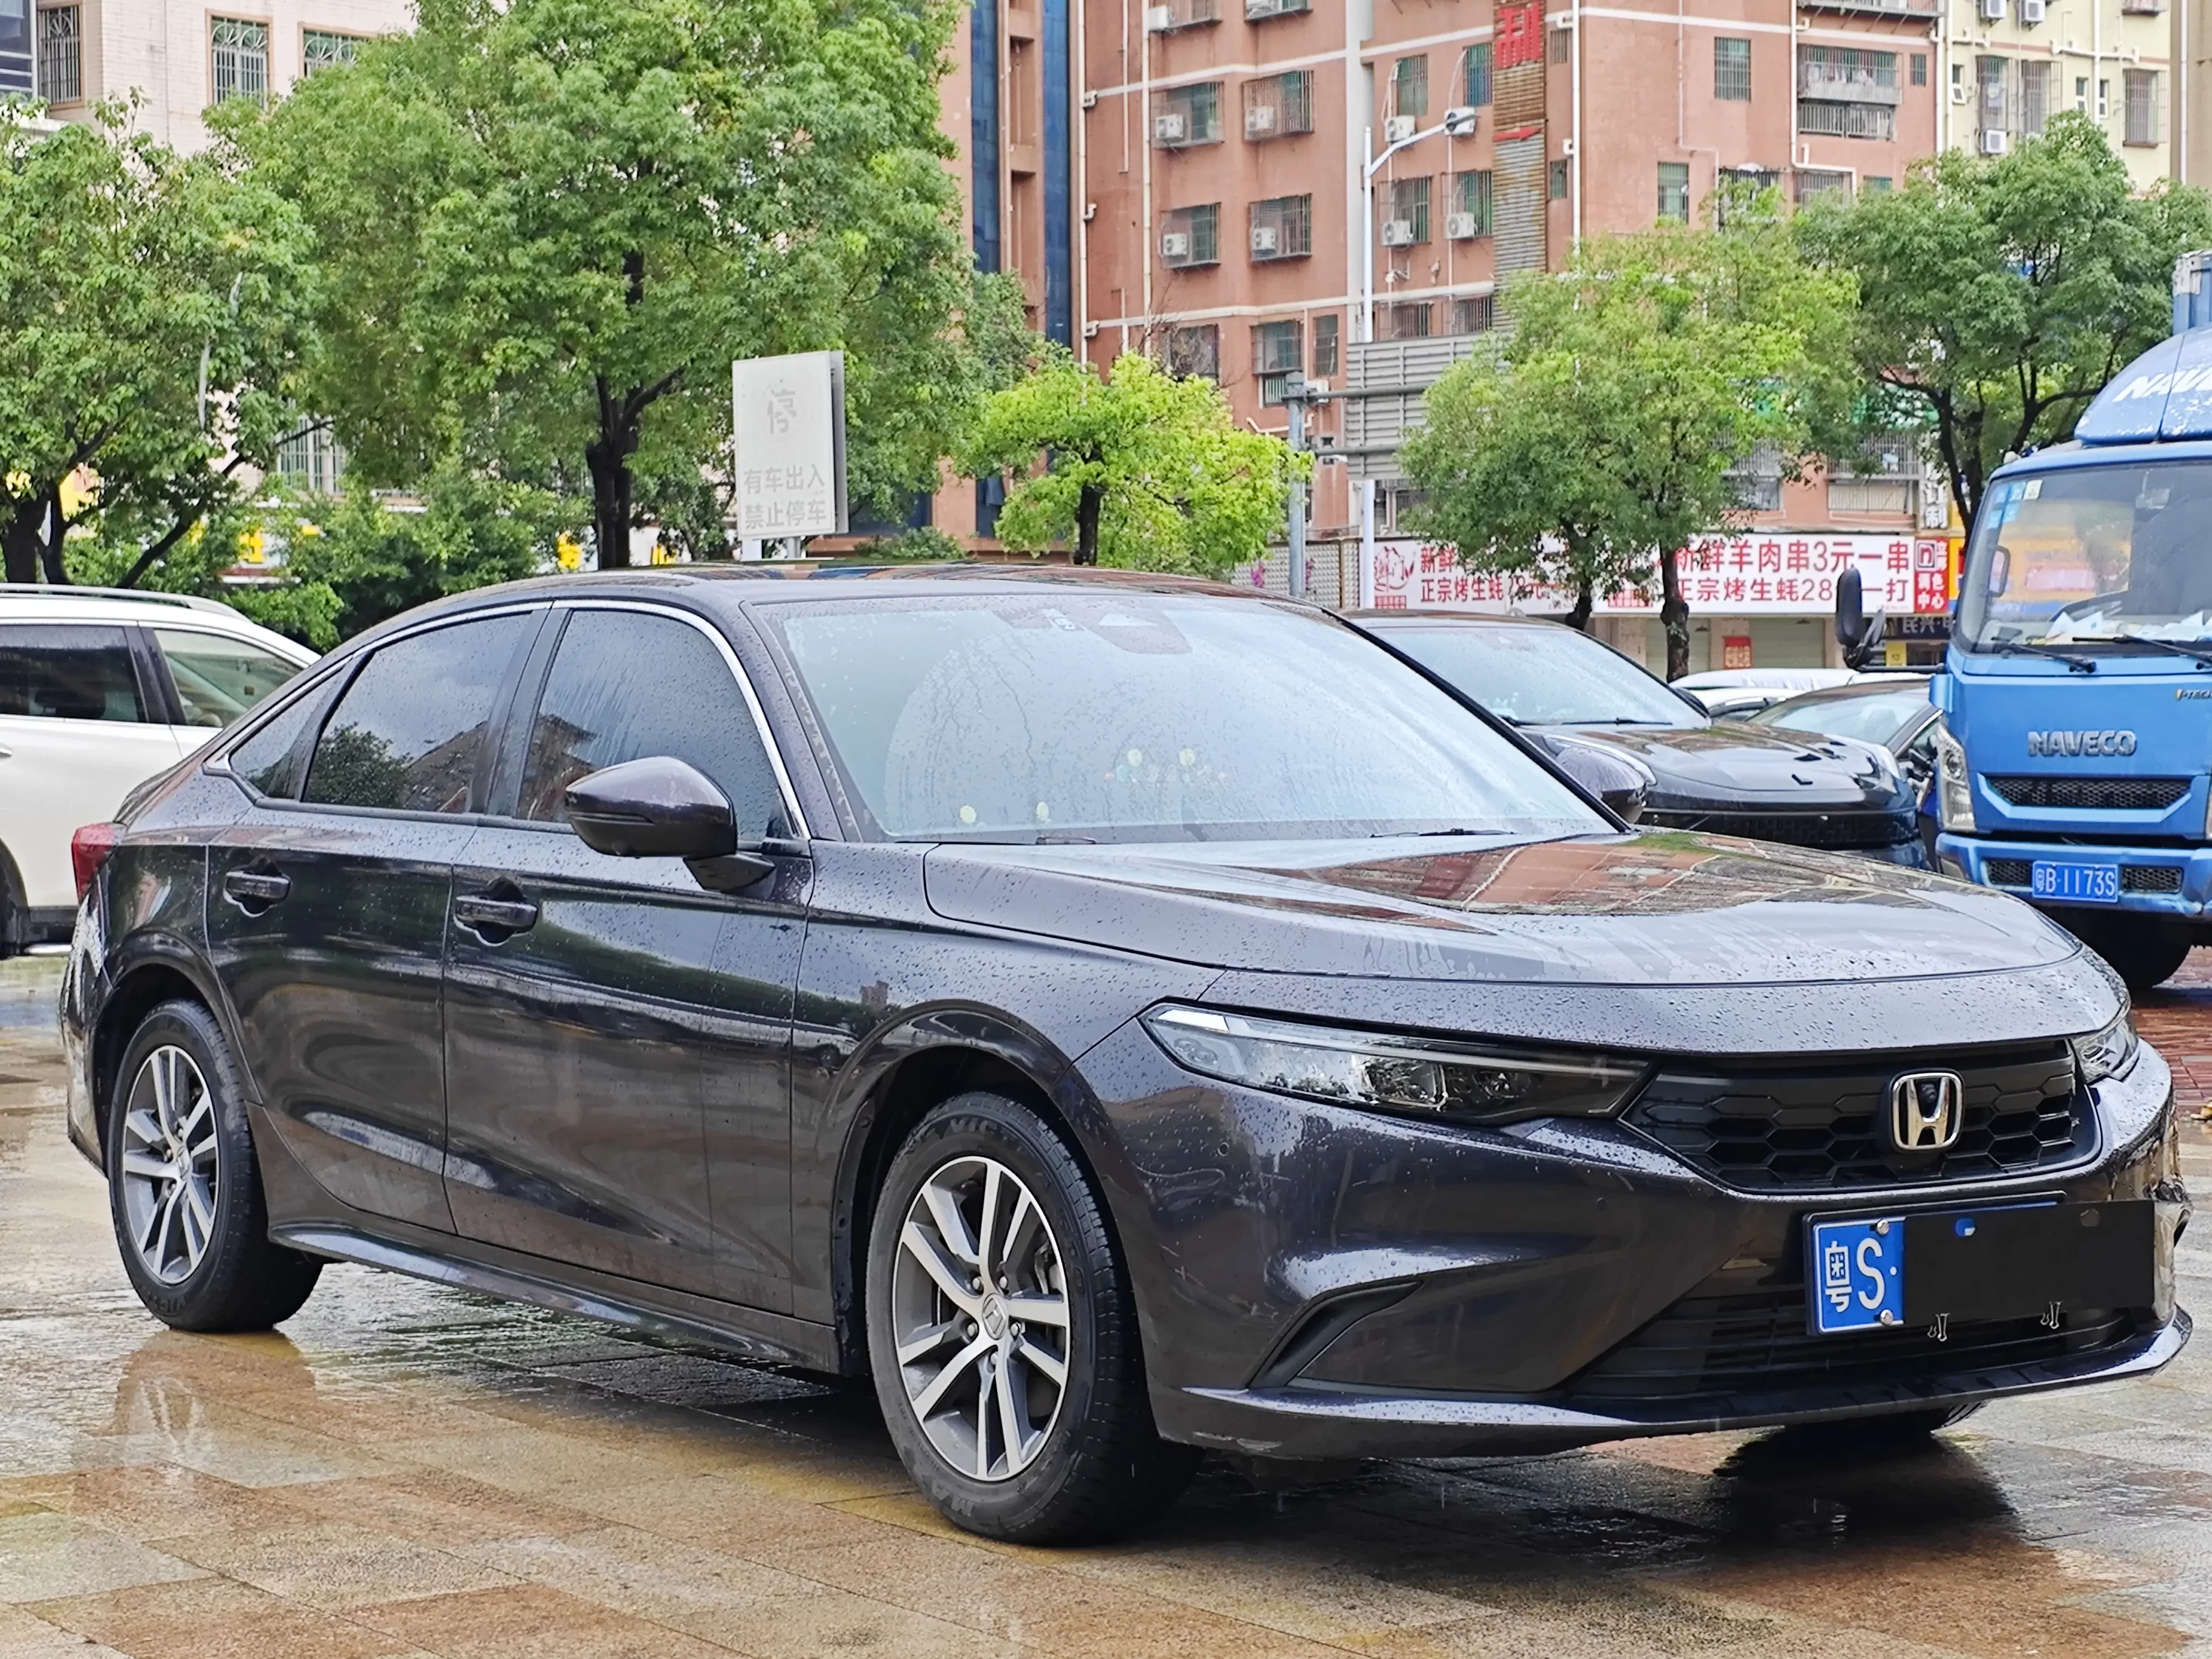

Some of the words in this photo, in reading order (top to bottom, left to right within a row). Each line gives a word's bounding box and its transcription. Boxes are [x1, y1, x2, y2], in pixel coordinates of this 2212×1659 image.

[743, 463, 825, 495] 有车出入
[745, 498, 827, 530] 禁止停车
[1677, 578, 1909, 602] 正宗烤生蚝28一打
[2028, 731, 2137, 757] NAVECO
